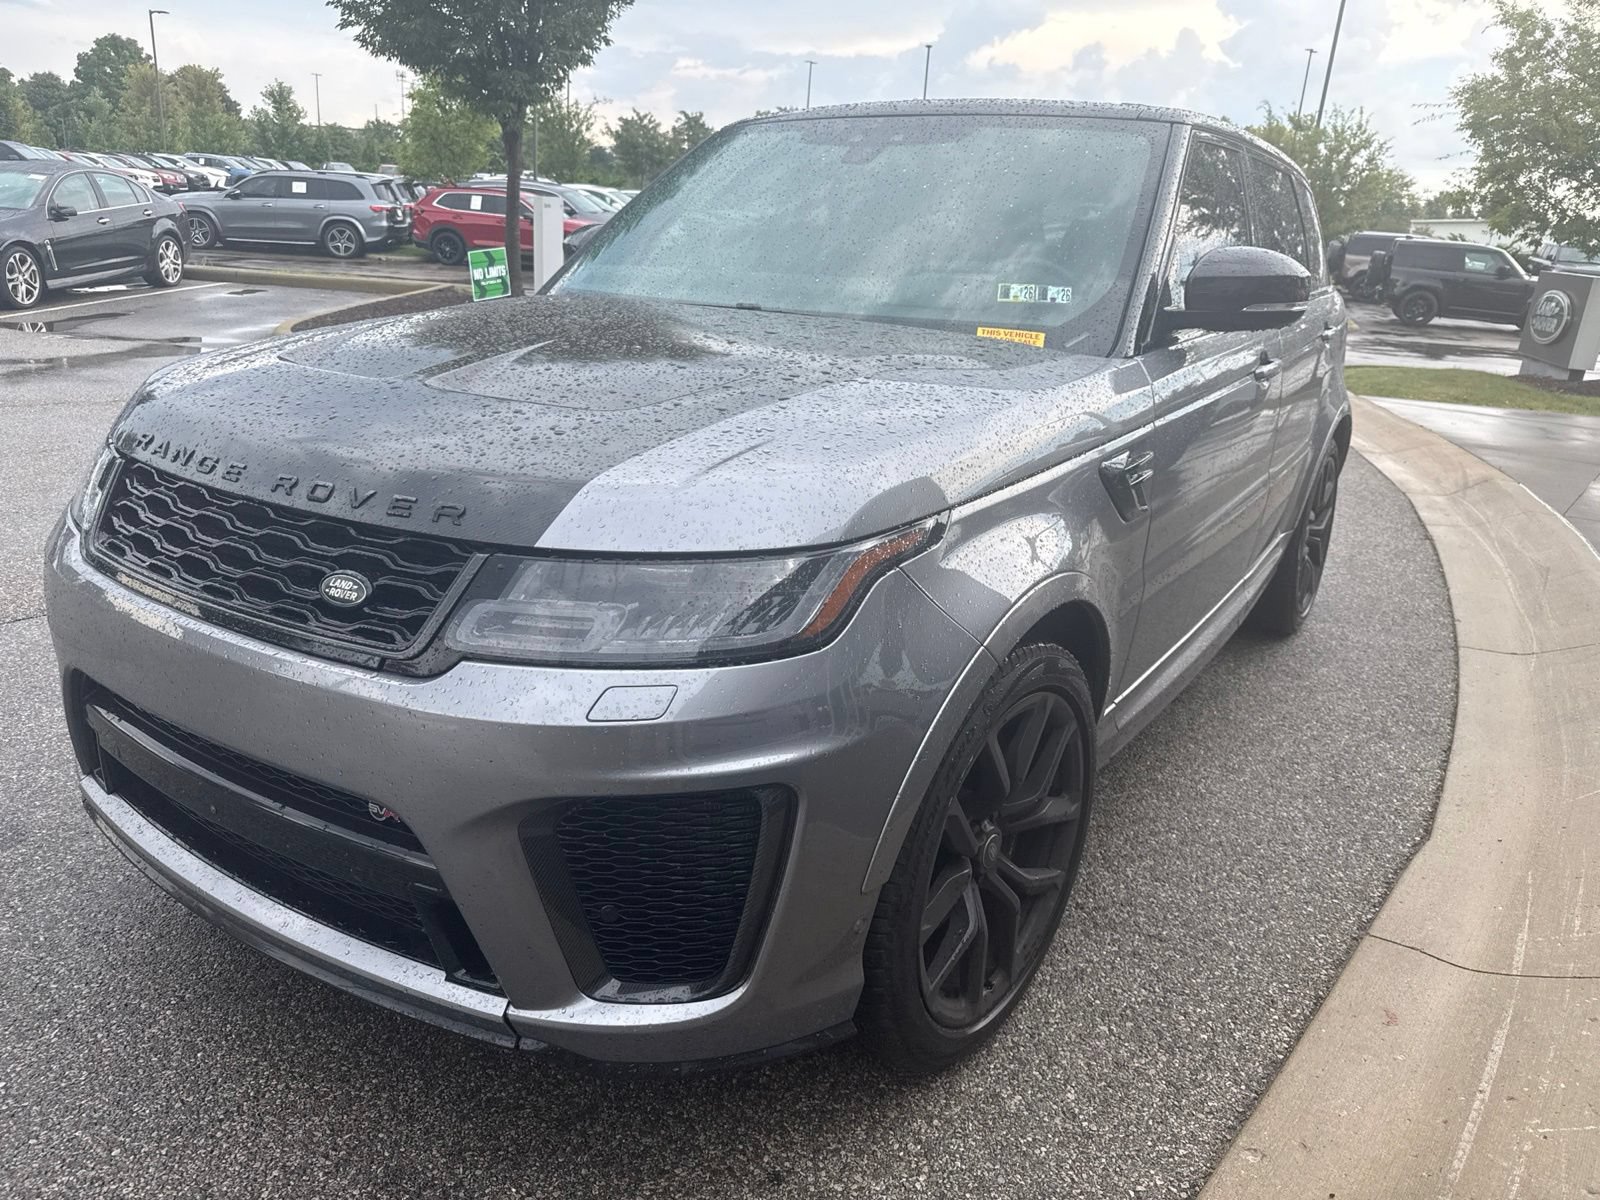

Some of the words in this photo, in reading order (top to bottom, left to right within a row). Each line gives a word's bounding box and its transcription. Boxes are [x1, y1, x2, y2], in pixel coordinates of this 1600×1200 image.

[473, 268, 484, 280] NO
[485, 265, 506, 278] LIMITS
[1024, 286, 1034, 300] 26
[1061, 288, 1071, 302] 26
[981, 329, 1001, 337] THIS
[1003, 331, 1041, 340] VEHICLE
[133, 433, 248, 483] RANGE
[270, 473, 467, 527] ROVER
